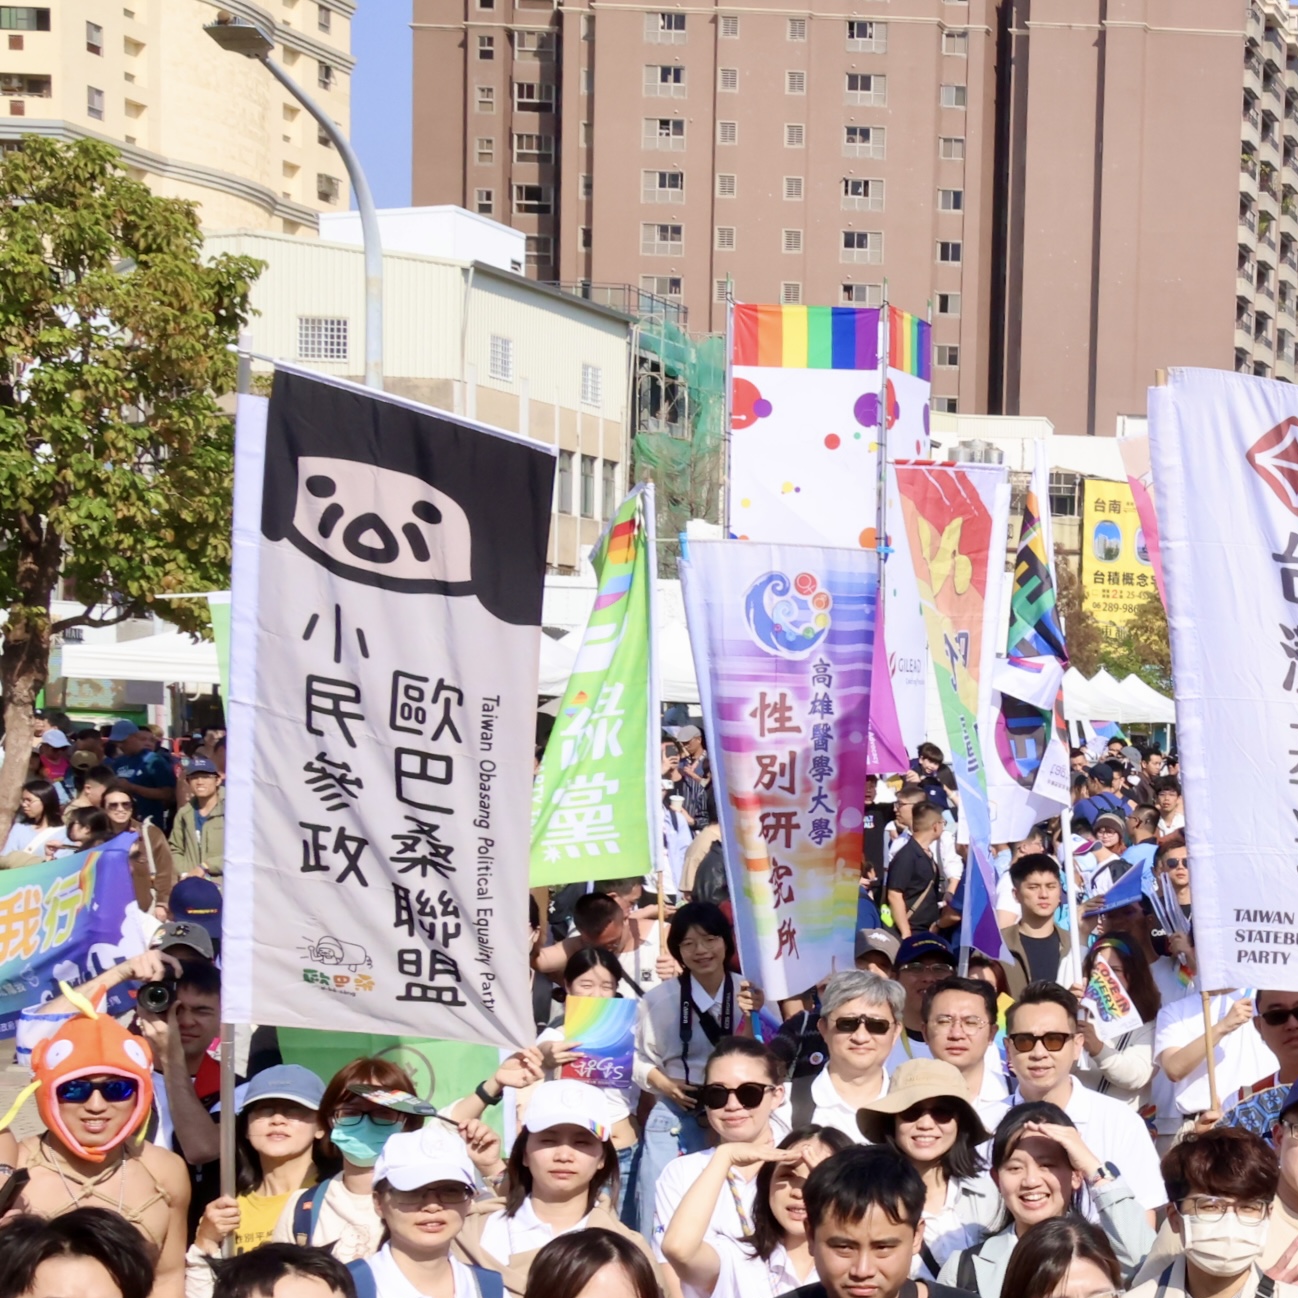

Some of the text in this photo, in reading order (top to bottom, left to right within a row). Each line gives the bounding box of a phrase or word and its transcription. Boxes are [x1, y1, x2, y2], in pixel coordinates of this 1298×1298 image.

[1093, 498, 1122, 514] 台南
[298, 602, 370, 888] 小民參政
[807, 657, 836, 846] 高雄醫學大學
[898, 657, 922, 674] GILEAD
[389, 669, 467, 1008] 歐巴桑聯盟
[473, 694, 501, 1013] Taiwan Obasang Political Equality Party
[541, 682, 626, 858] 綠黨
[747, 690, 804, 961] 性別研究所
[1233, 908, 1295, 926] TAIWAN
[1236, 948, 1292, 966] PARTY
